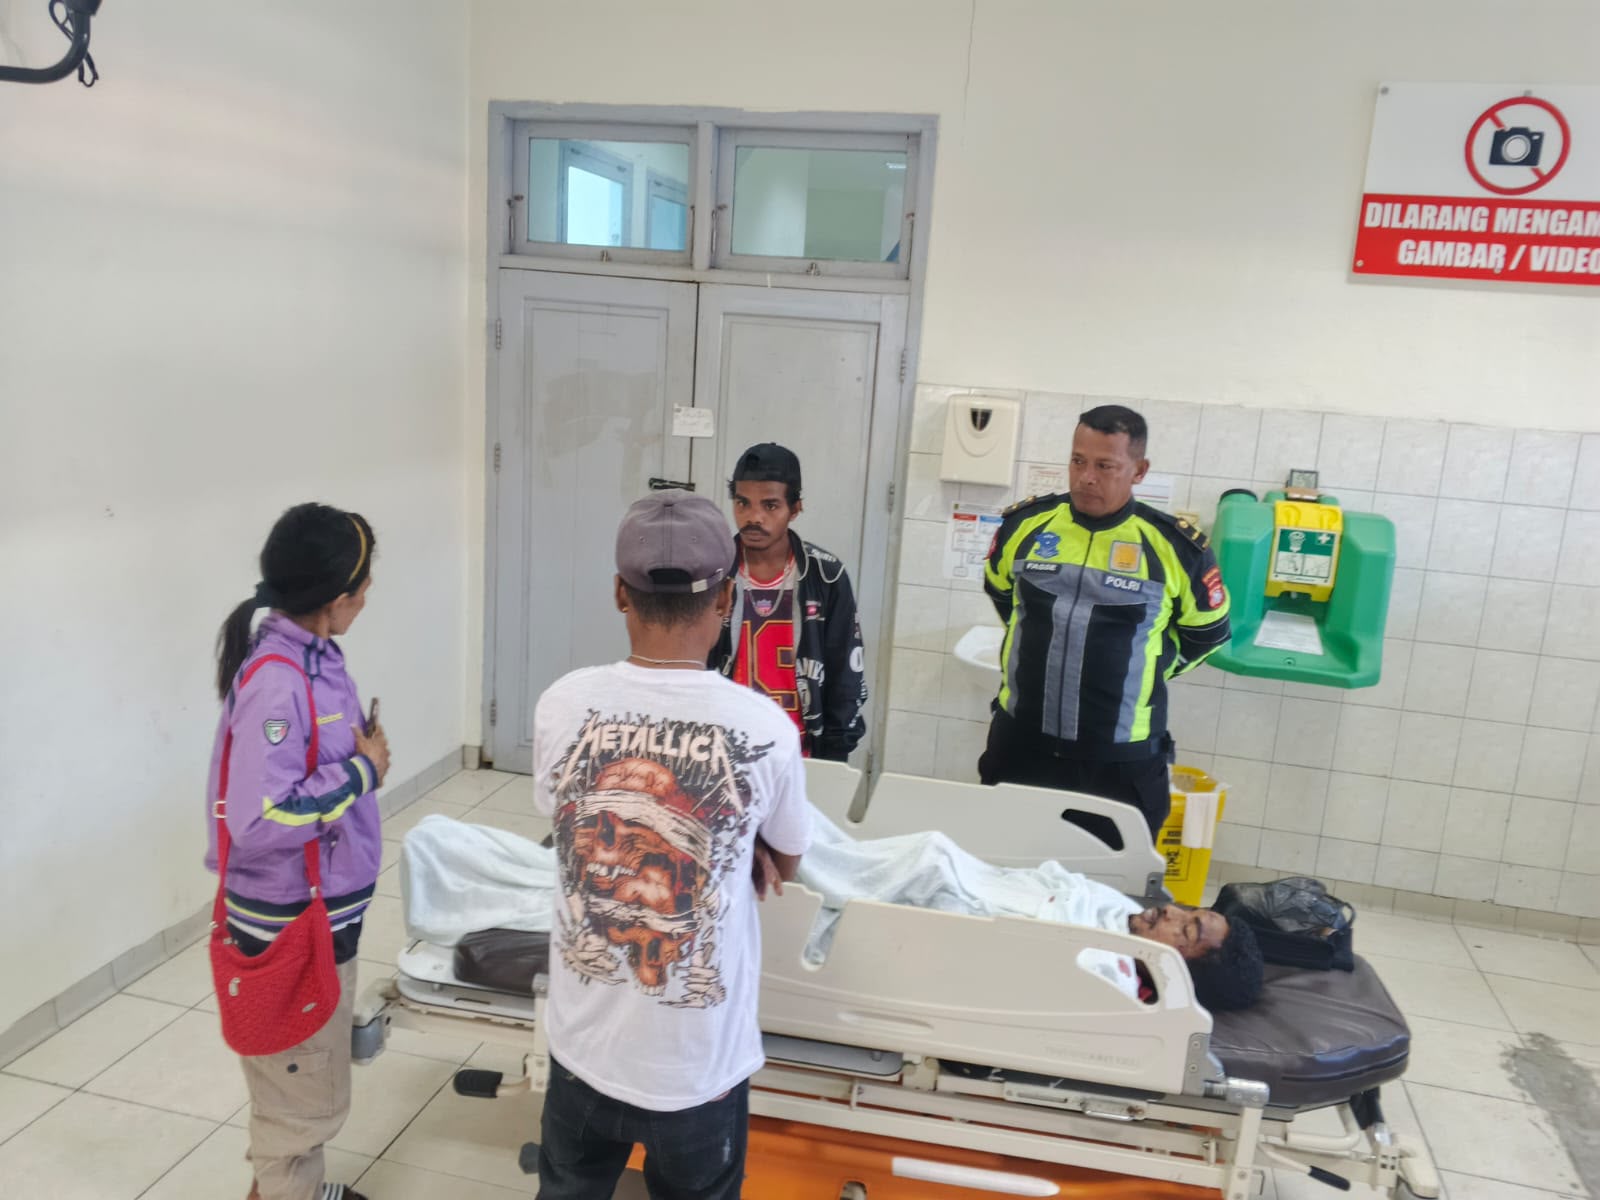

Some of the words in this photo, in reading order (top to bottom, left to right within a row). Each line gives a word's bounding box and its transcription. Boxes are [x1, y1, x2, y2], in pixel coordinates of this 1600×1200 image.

[1364, 202, 1489, 233] DILARANG
[1397, 239, 1507, 270] GAMBAR
[1509, 245, 1527, 271] /
[1104, 575, 1142, 592] POLRI
